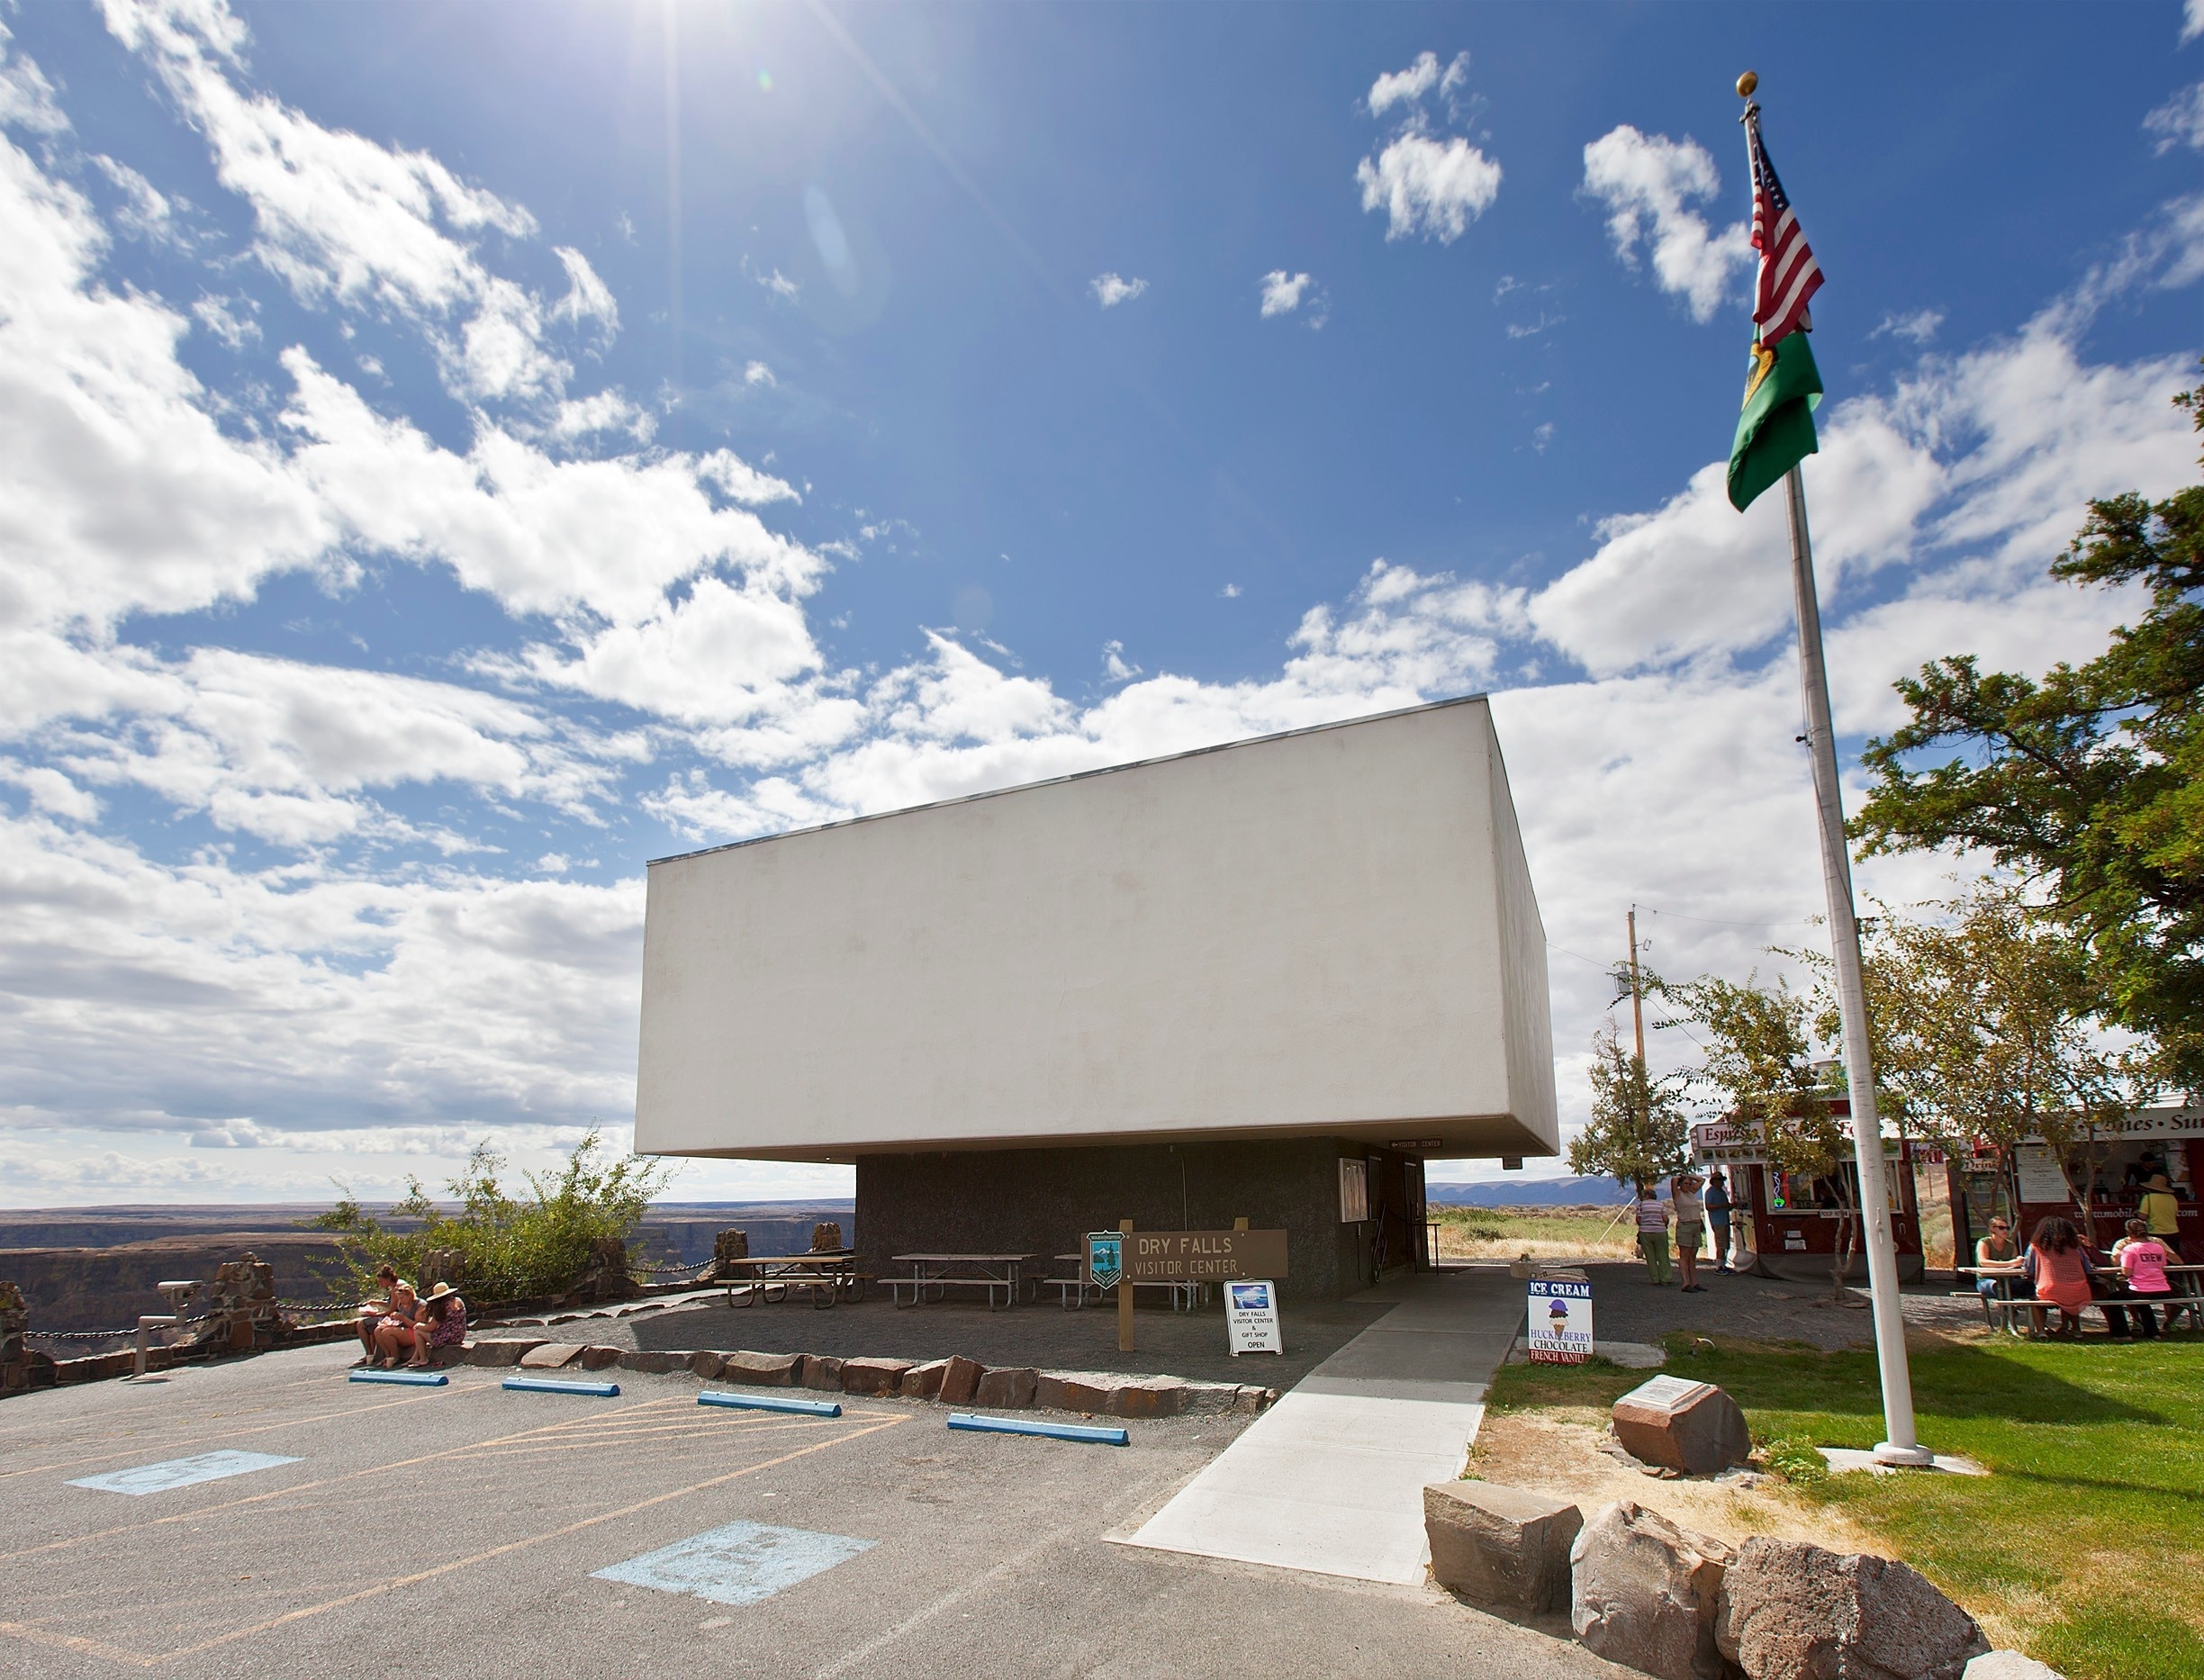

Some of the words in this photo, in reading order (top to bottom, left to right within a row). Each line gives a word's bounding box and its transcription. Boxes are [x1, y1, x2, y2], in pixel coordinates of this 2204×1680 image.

[1139, 1238, 1170, 1255] DRY
[1180, 1237, 1232, 1254] FALLS
[2139, 1253, 2163, 1263] CREW
[1134, 1260, 1183, 1275] VISITOR
[1189, 1259, 1238, 1274] CENTER
[1530, 1281, 1548, 1295] ICE
[1550, 1283, 1590, 1297] CREAM
[1533, 1340, 1588, 1353] CHOCOLATE
[1531, 1350, 1558, 1362] FRENCH
